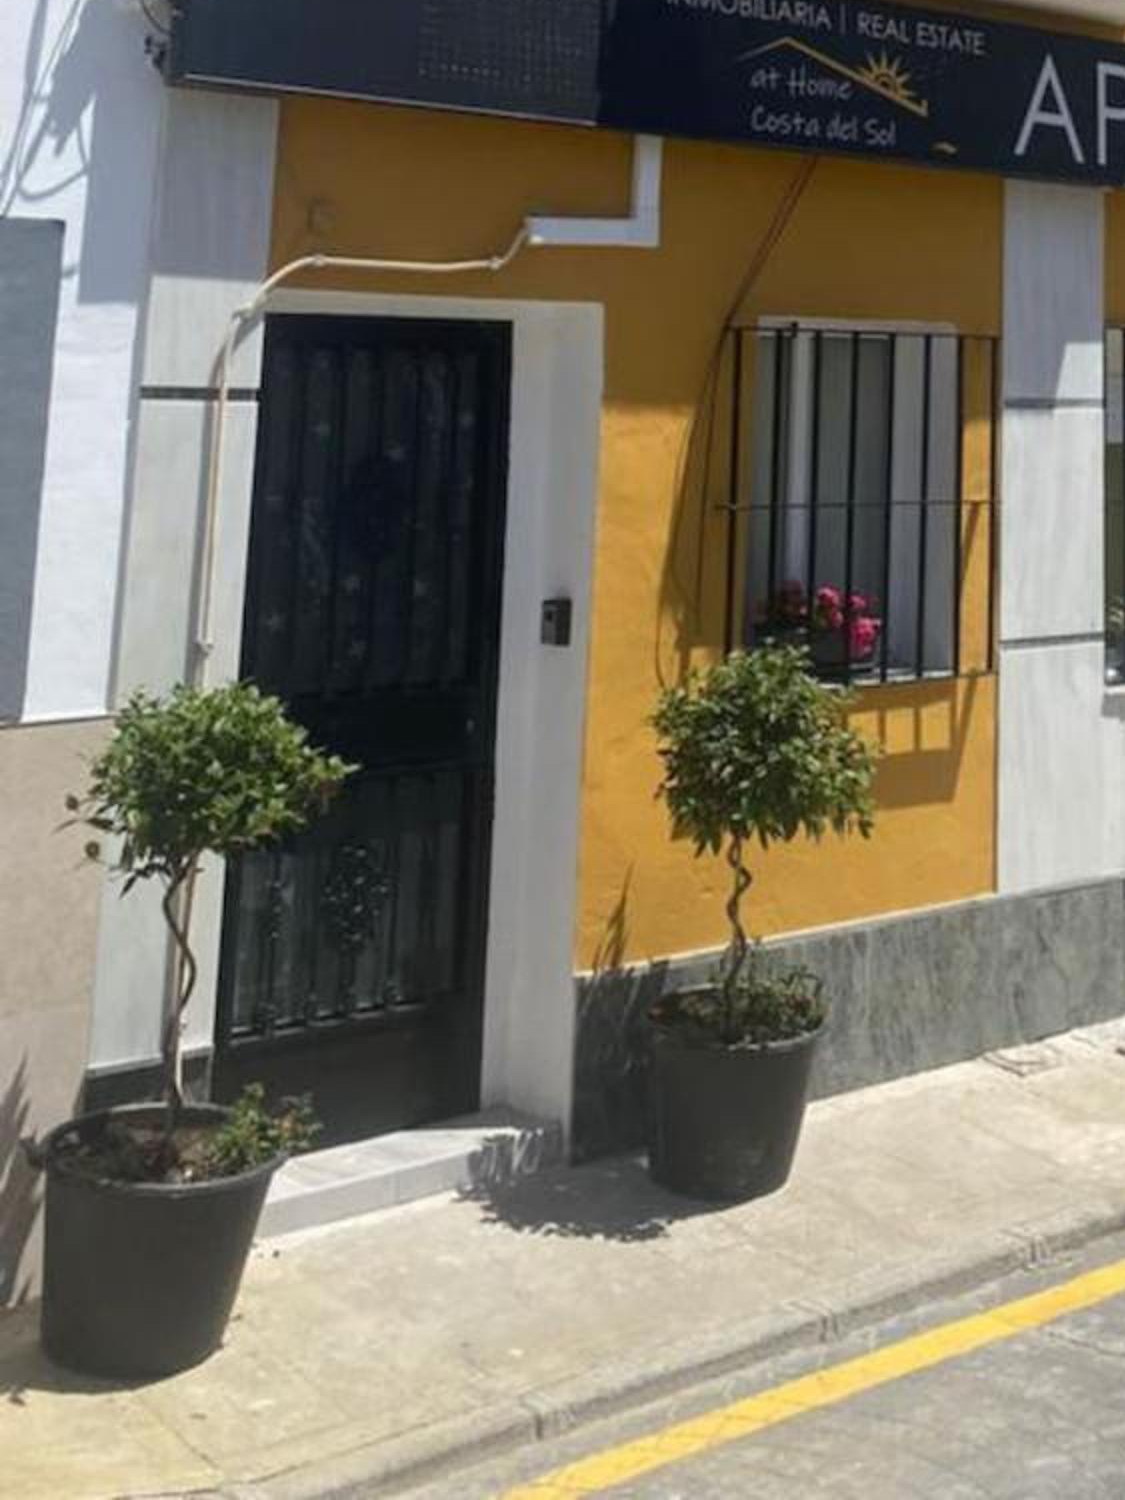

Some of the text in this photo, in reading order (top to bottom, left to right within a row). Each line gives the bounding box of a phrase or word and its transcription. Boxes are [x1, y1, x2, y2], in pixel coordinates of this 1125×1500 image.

[856, 11, 910, 45] REAL
[917, 21, 986, 55] ESTATE
[751, 64, 853, 100] at Home
[751, 105, 897, 147] Costa del Sol
